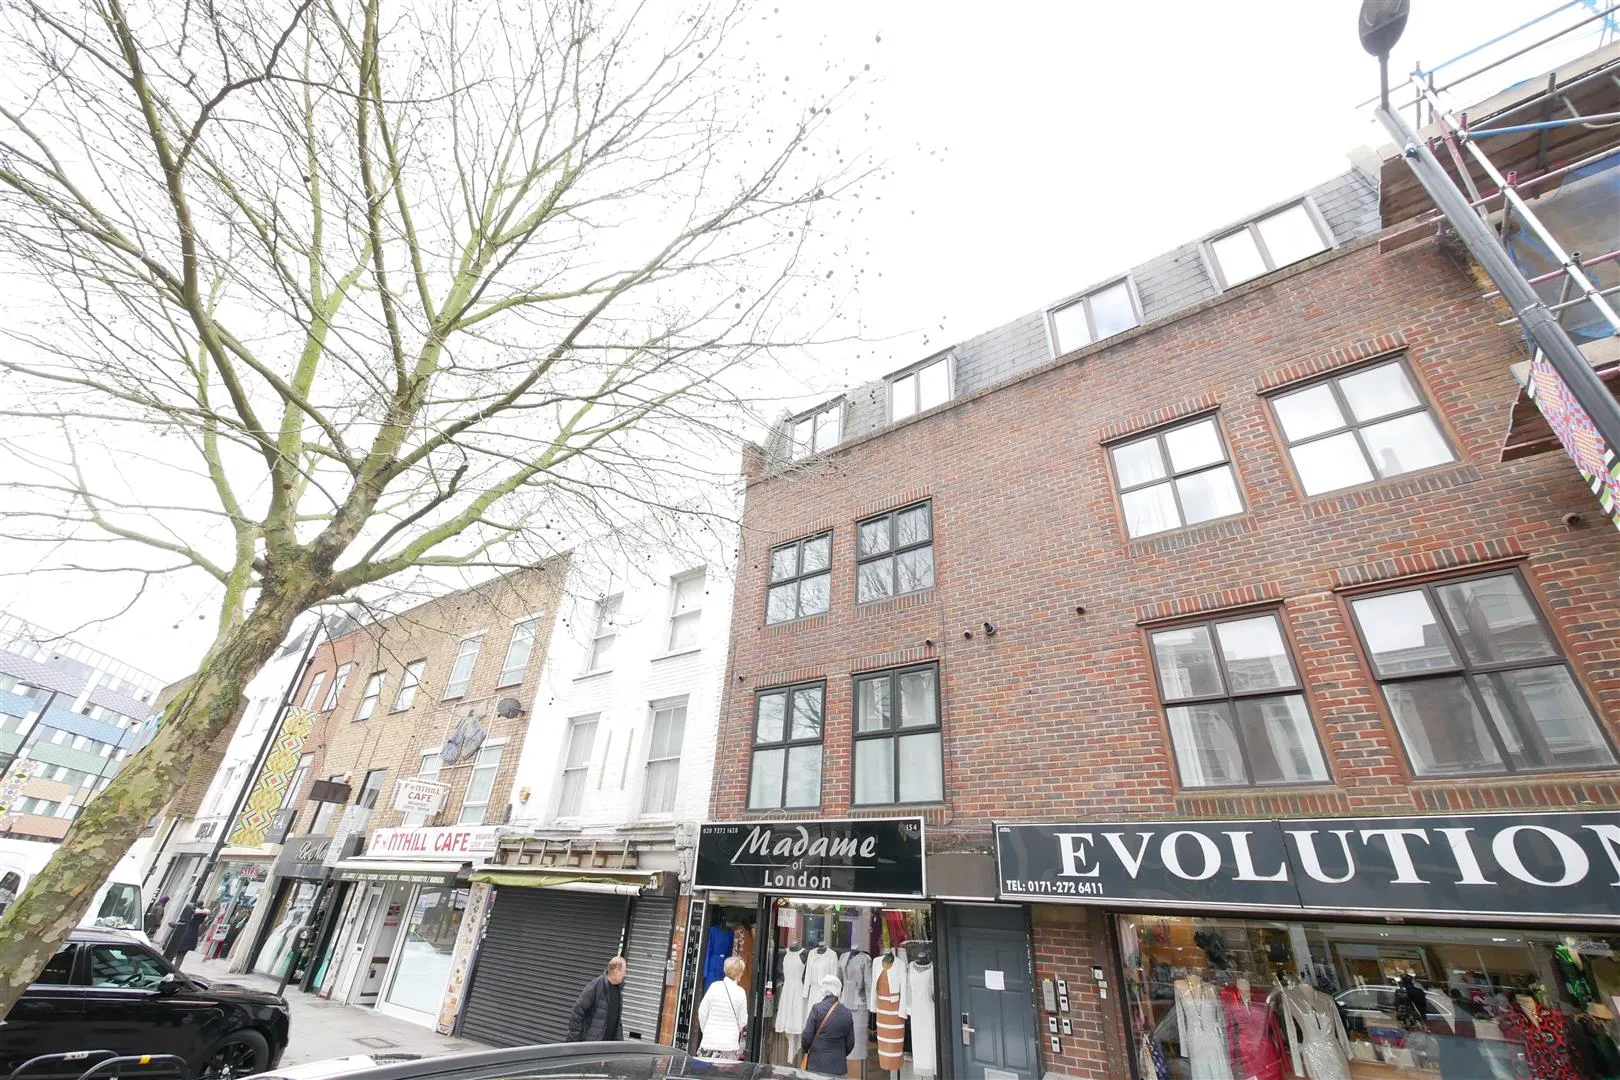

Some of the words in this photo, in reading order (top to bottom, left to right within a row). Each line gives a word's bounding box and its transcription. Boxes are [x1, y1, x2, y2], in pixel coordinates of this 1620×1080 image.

[407, 791, 433, 803] CAFE
[434, 832, 471, 852] CAFE
[730, 825, 876, 864] Madame
[792, 858, 804, 870] of
[763, 870, 831, 889] London
[1006, 880, 1026, 892] TEL:
[1028, 881, 1076, 894] 0171-272
[1078, 882, 1104, 894] 6411
[679, 924, 698, 1025] WHOLESALE
[685, 943, 700, 1026] RETAIL
[676, 1031, 690, 1041] SIZE
